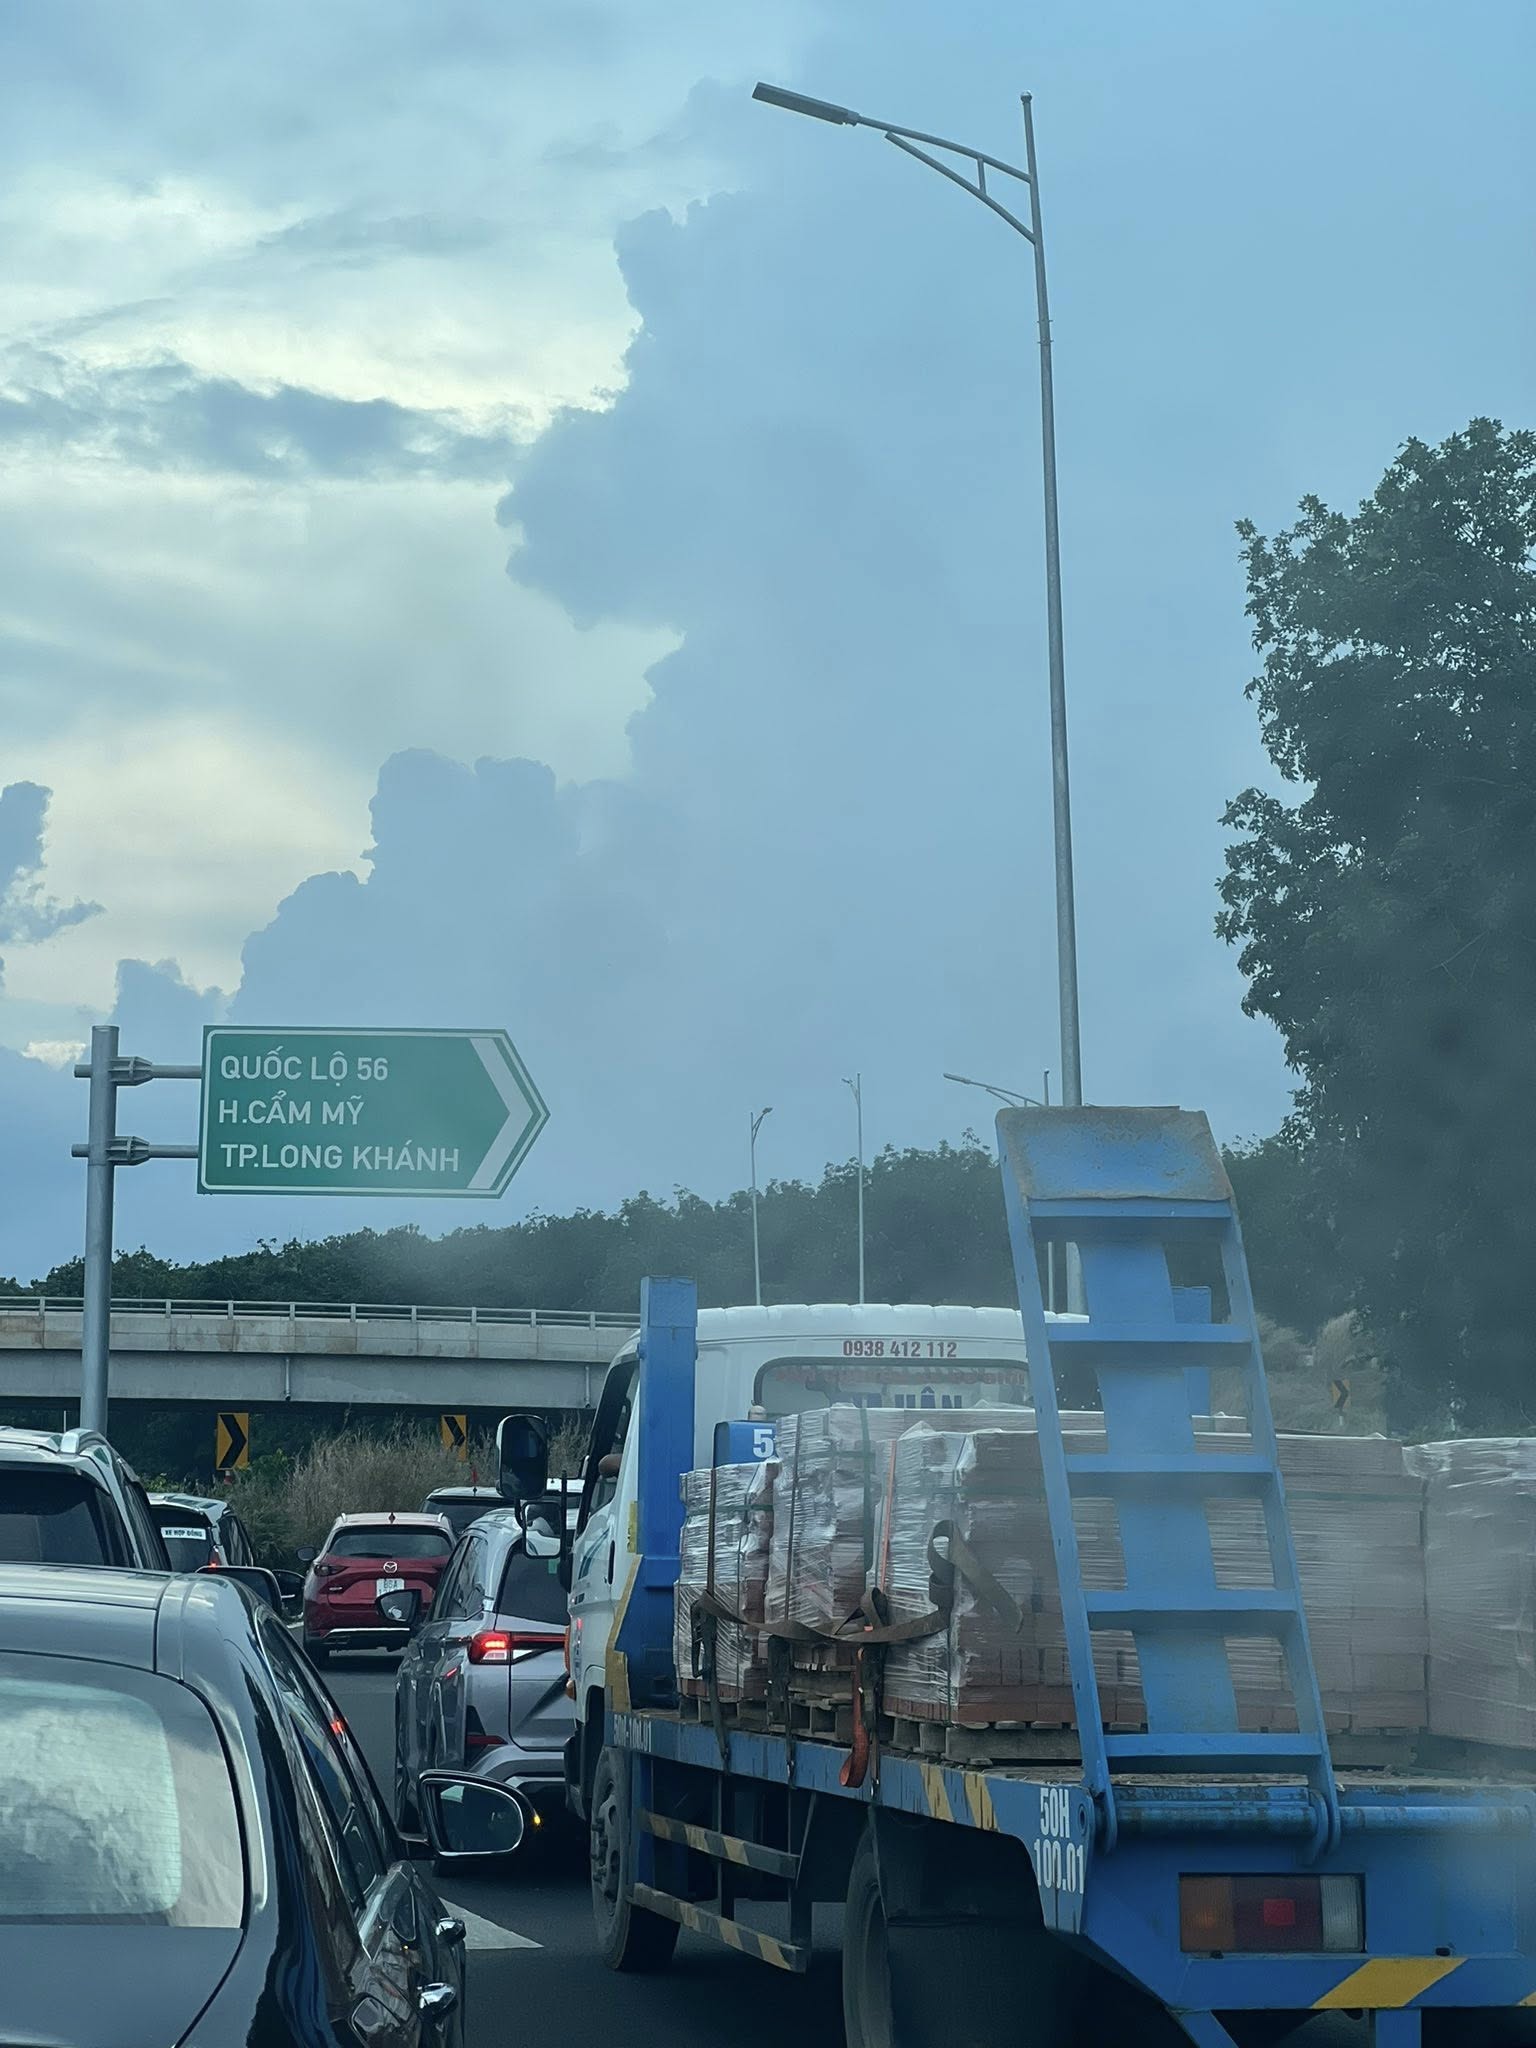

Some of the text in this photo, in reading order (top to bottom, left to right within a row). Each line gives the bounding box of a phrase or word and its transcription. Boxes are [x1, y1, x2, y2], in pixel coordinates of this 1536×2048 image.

[220, 1045, 389, 1087] QUỐC LỘ 56
[218, 1089, 365, 1126] H.CẨM MỸ
[220, 1139, 460, 1172] TP.LONG KHÁNH
[843, 1340, 957, 1358] 0938 412 112
[1039, 1787, 1071, 1839] 50H
[1033, 1838, 1084, 1894] 100.01
